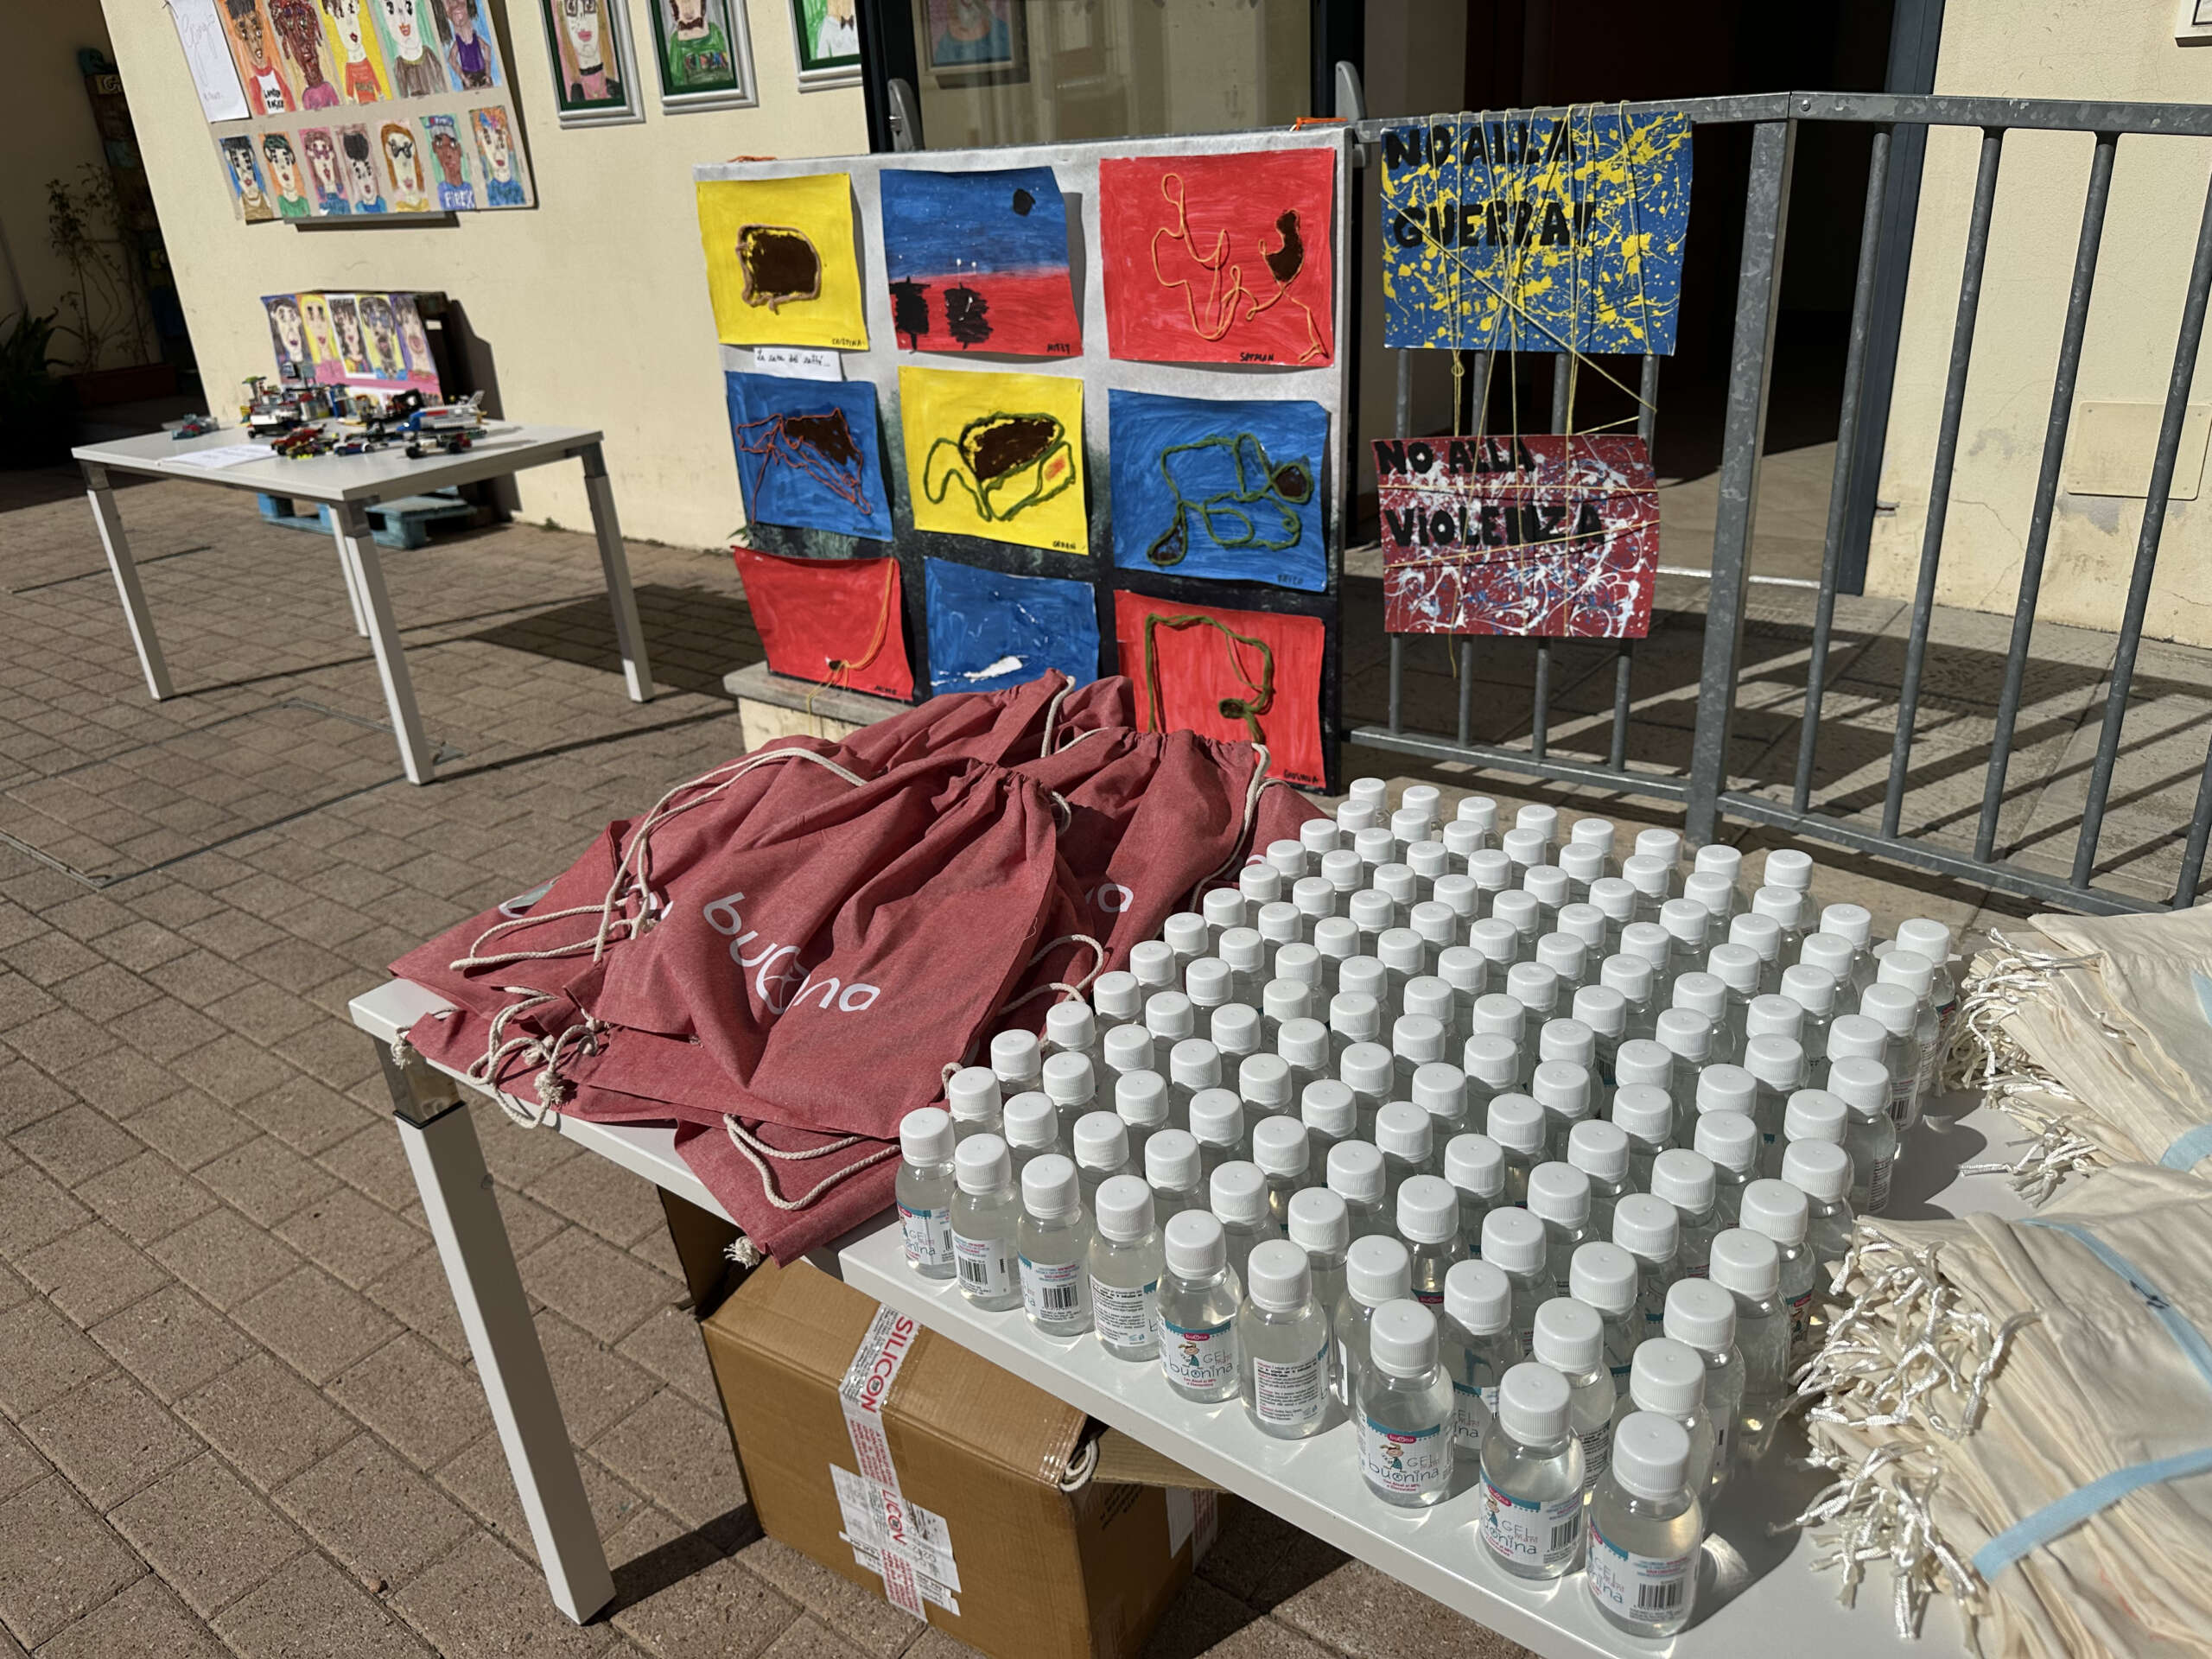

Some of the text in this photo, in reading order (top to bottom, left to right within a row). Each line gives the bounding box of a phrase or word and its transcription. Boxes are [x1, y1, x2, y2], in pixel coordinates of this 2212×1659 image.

[1384, 120, 1577, 170] NO ALLA
[1393, 200, 1597, 248] GUERRA!
[1374, 435, 1536, 475] NO ALLA
[861, 1315, 914, 1414] SILICON
[1168, 1354, 1233, 1378] buonina
[1368, 1453, 1439, 1483] buonina
